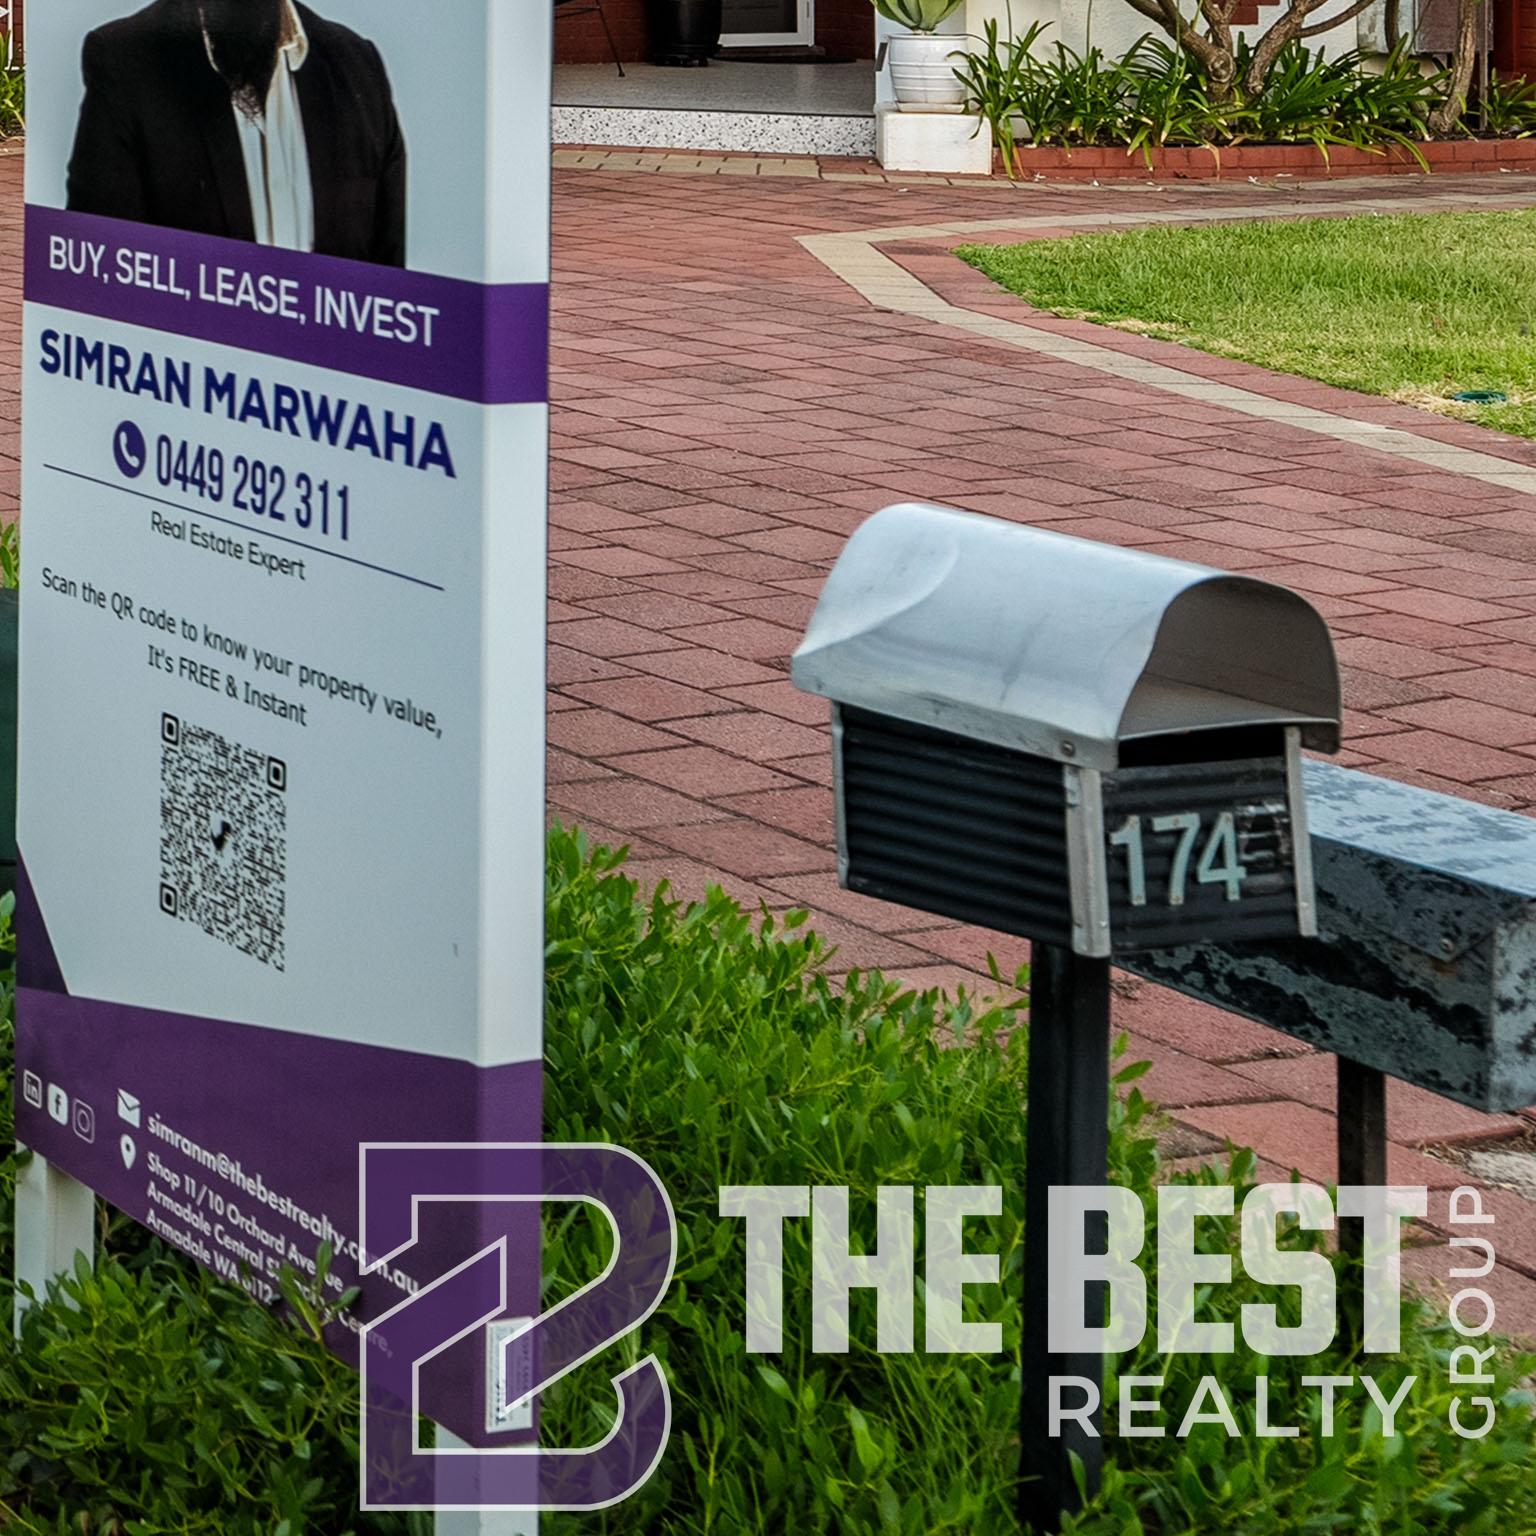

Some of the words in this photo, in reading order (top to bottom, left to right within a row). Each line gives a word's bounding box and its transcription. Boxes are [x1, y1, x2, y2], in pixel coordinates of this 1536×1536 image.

[49, 235, 110, 285] BUY,
[115, 248, 192, 301] SELL,
[198, 263, 307, 326] LEASE,
[314, 285, 440, 347] INVEST
[39, 328, 192, 408] SIMRAN
[203, 366, 458, 479] MARWAHA
[156, 433, 225, 503] 0449
[233, 454, 287, 522] 292
[295, 471, 350, 541] 311
[150, 511, 186, 542] Real
[190, 524, 244, 560] Estate
[248, 539, 306, 581] Expert
[42, 568, 77, 598] Scan
[81, 581, 106, 610] the
[110, 591, 135, 621] QR
[138, 601, 177, 635] code
[181, 619, 199, 643] to
[203, 624, 248, 662] know
[253, 645, 294, 680] your
[299, 663, 378, 714] property
[384, 693, 444, 739] value,
[147, 644, 174, 675] It's
[178, 656, 221, 693] FREE
[226, 674, 239, 700] &
[244, 681, 308, 727] Instant
[1109, 812, 1247, 907] 174
[145, 1207, 212, 1265] Armadale
[213, 1250, 241, 1285] WA
[146, 1151, 180, 1191] Shop
[226, 1203, 286, 1256] Orchard
[288, 1242, 344, 1293] Aveue
[146, 1180, 212, 1237] Armadale
[213, 1222, 265, 1273] Central
